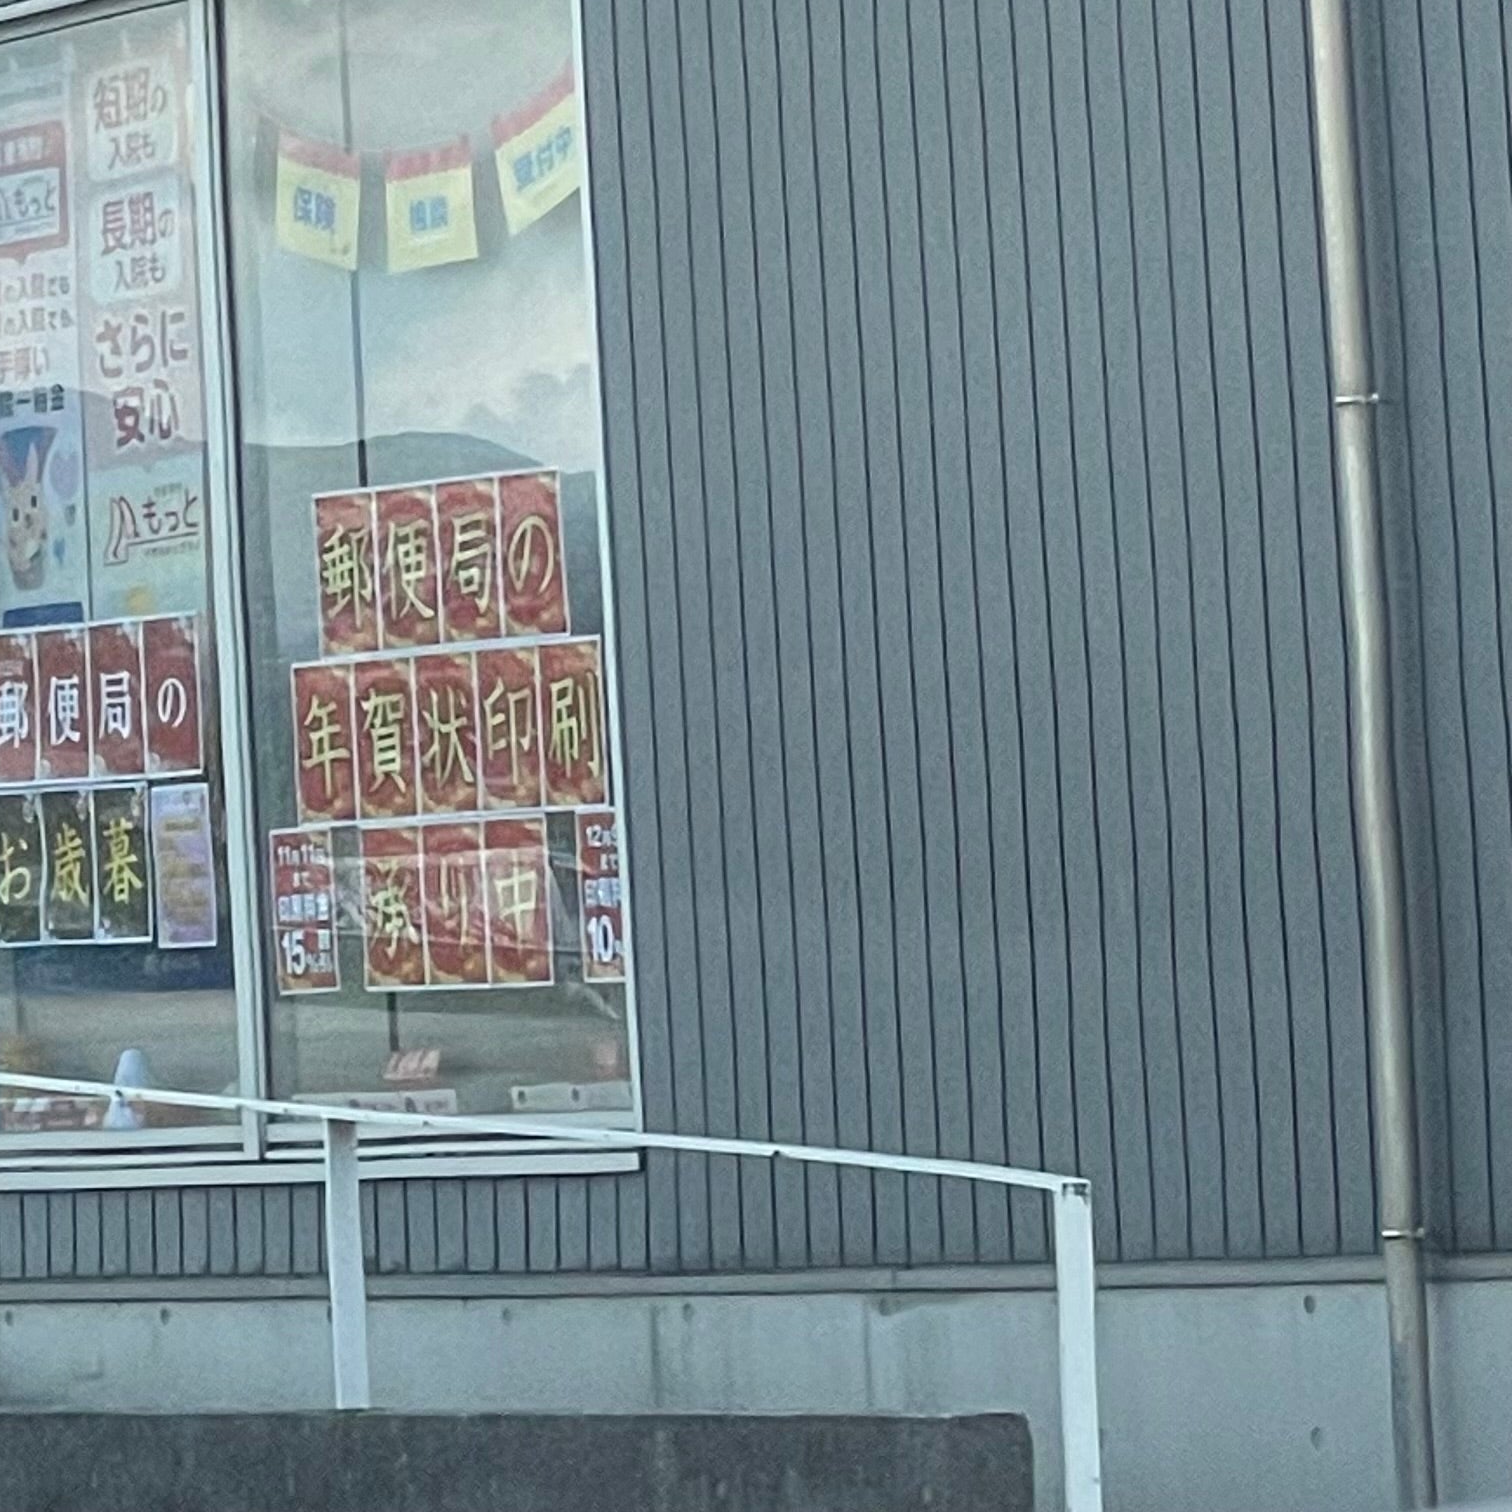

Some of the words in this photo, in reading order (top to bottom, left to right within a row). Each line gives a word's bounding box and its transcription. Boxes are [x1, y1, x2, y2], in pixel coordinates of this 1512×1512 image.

[101, 191, 175, 256] 長期の
[96, 310, 188, 378] さらに
[114, 378, 179, 447] 安心
[142, 490, 199, 535] もっと
[321, 513, 555, 630] 郵便局の
[302, 670, 601, 799] 年賀状印刷
[367, 851, 538, 958] 承り中
